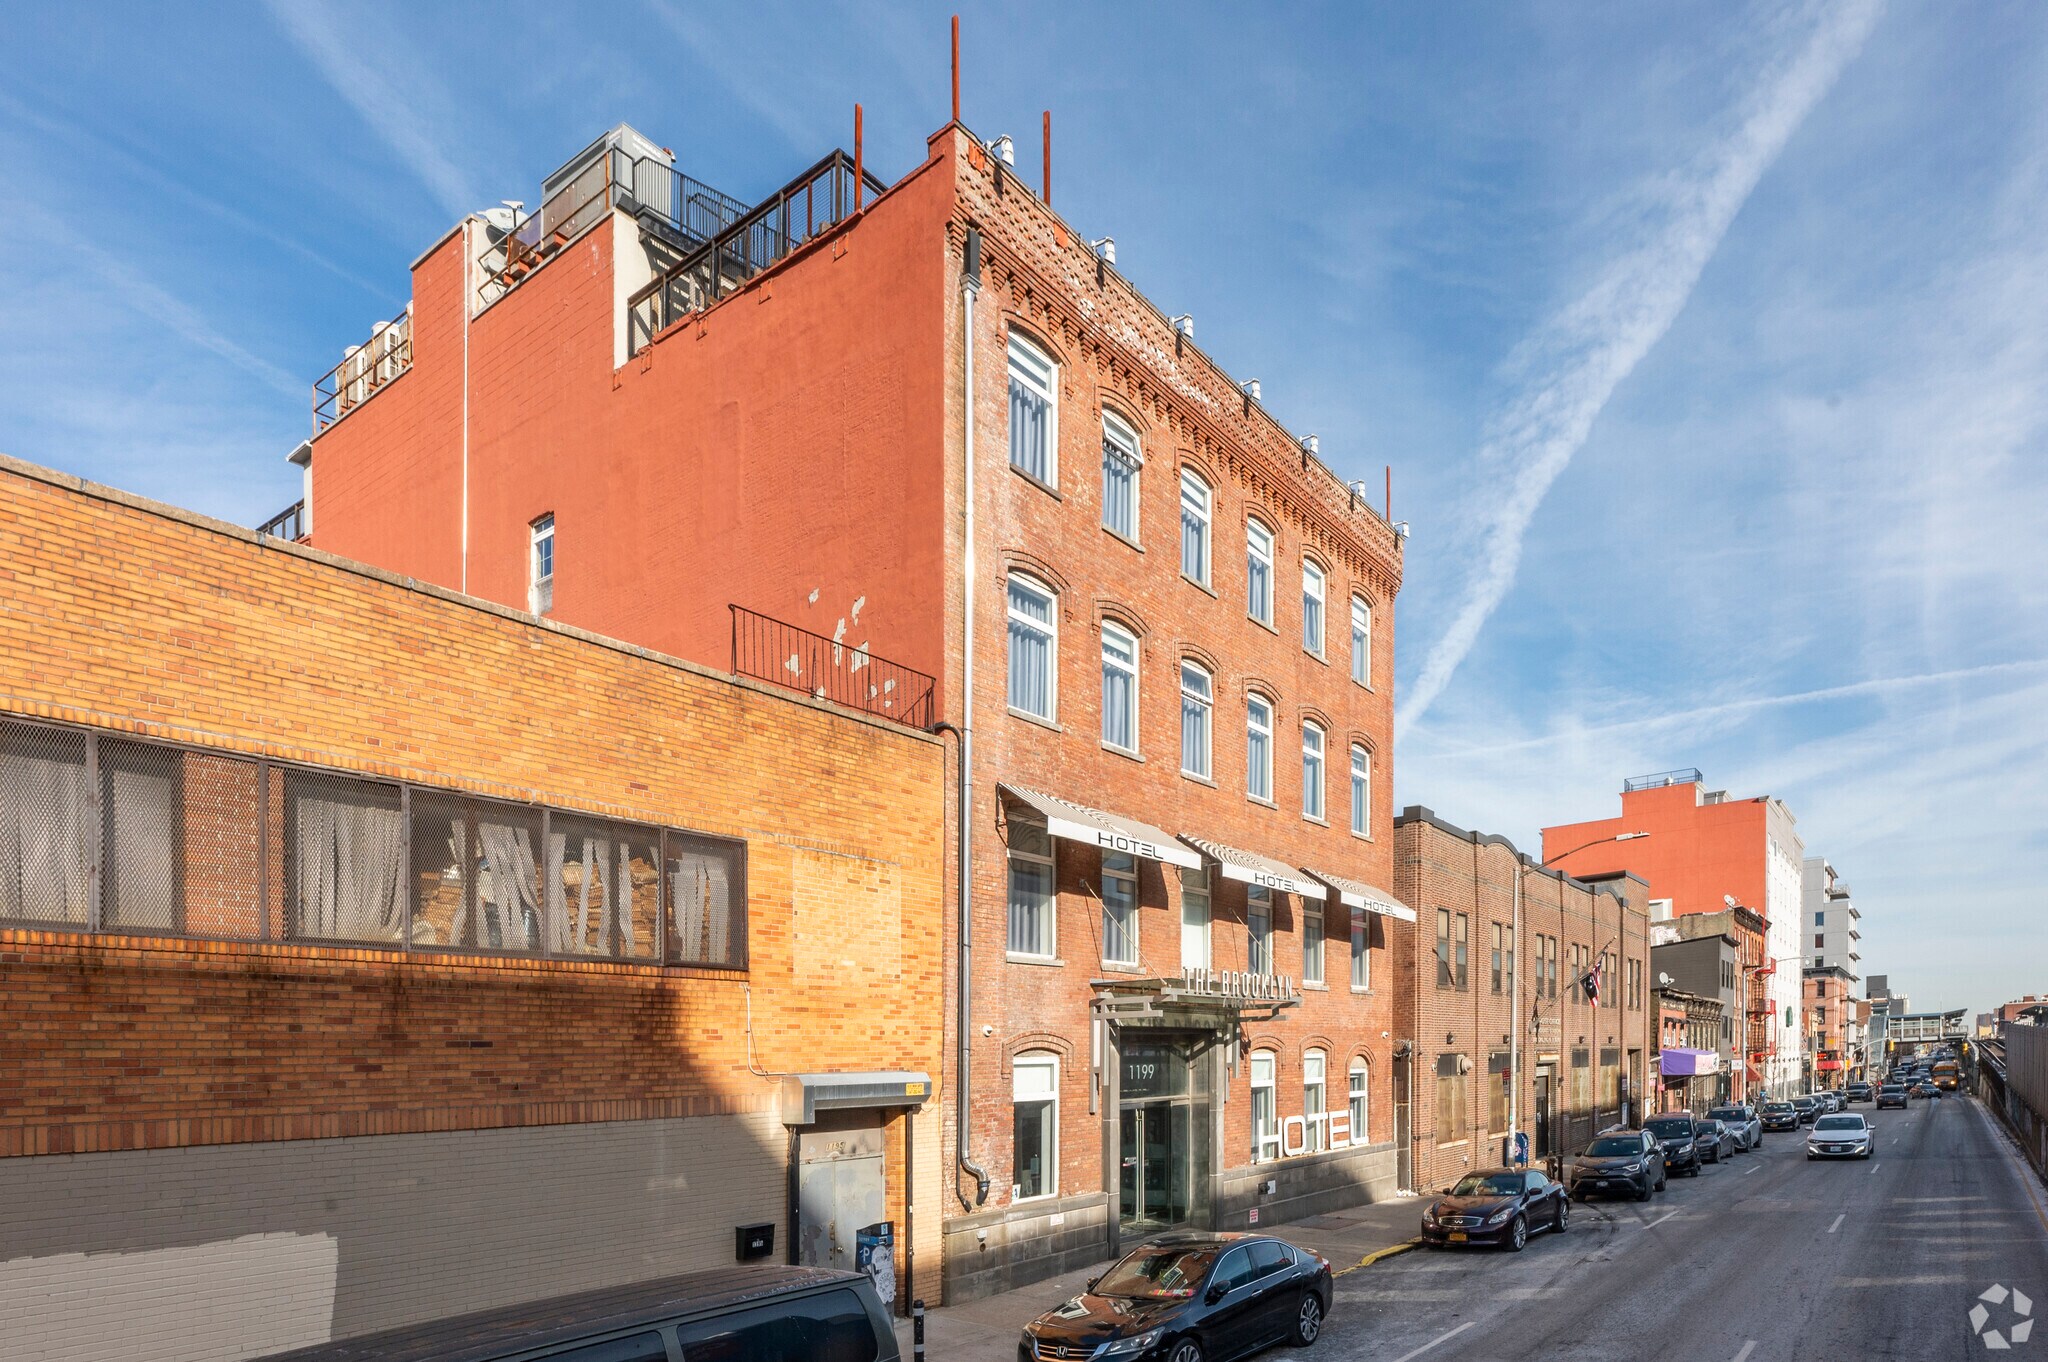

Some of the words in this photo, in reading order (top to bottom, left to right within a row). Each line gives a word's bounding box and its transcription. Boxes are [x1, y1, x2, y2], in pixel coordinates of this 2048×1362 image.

[1098, 832, 1164, 860] HOTEL
[1255, 872, 1300, 893] HOTEL
[1363, 899, 1397, 916] HOTEL
[1183, 967, 1214, 995] THE
[1221, 970, 1293, 1000] BROOKLYN
[1129, 1064, 1155, 1080] 1199
[1258, 1109, 1369, 1161] HOTEL
